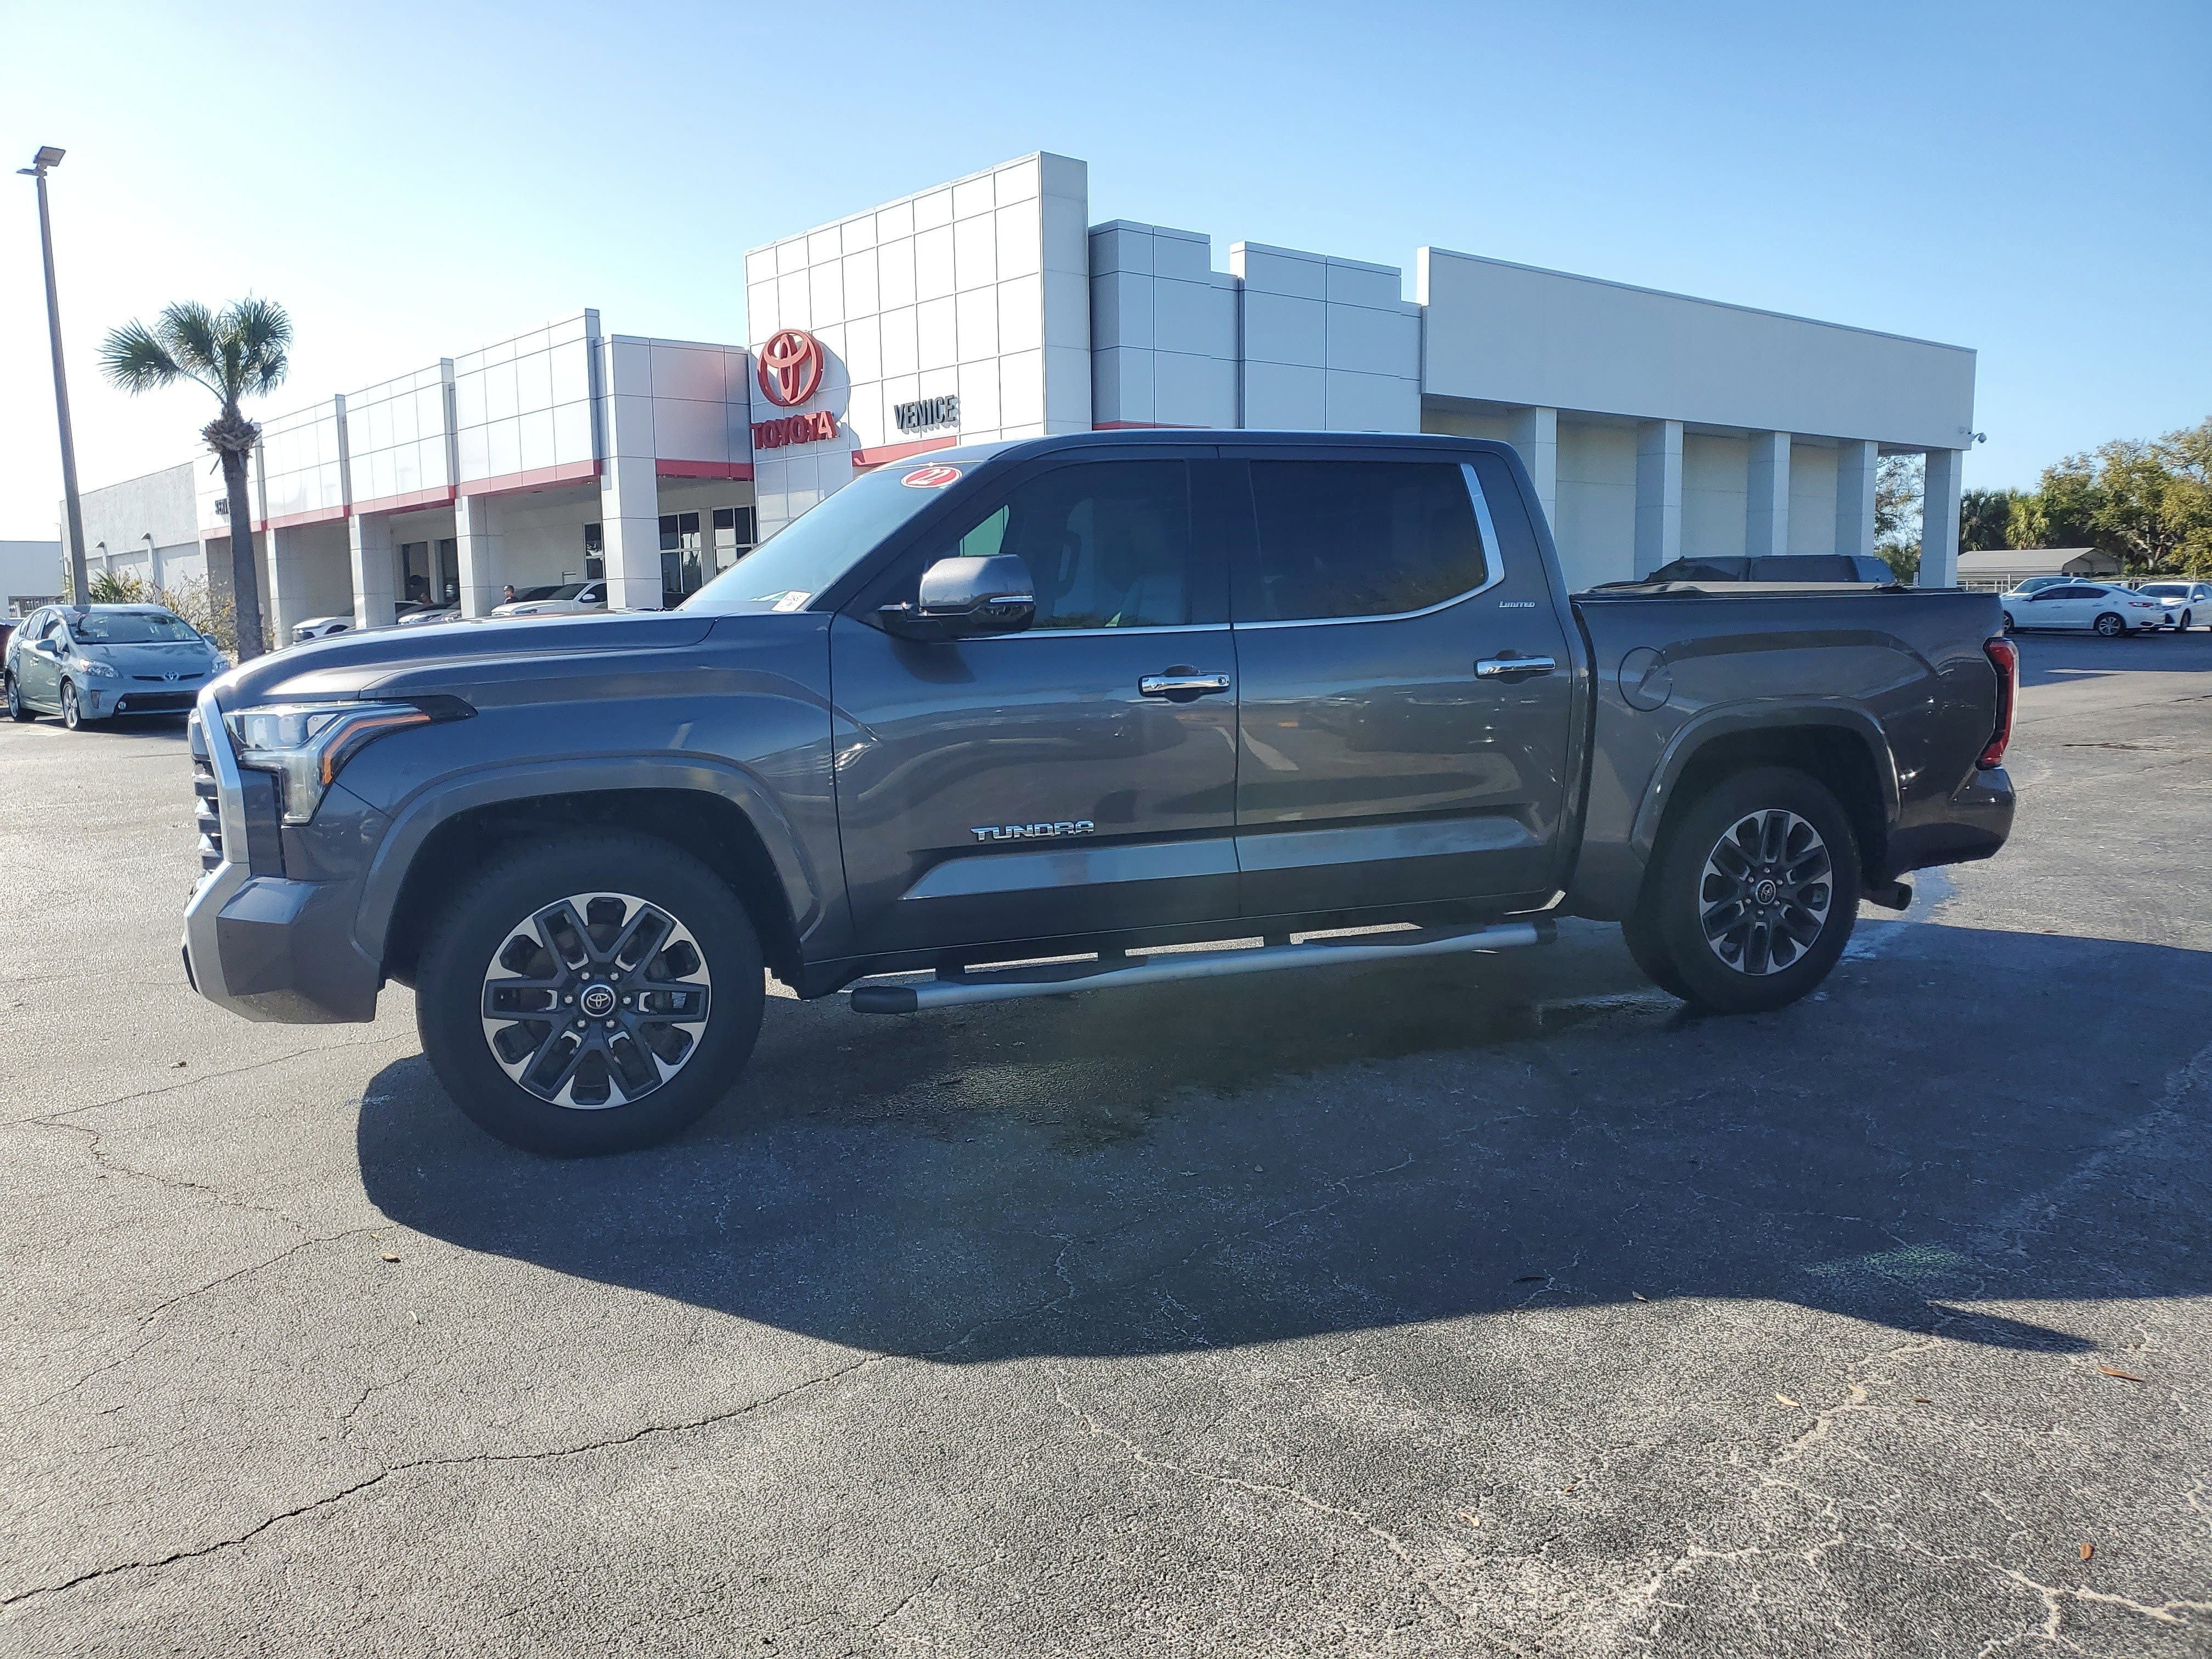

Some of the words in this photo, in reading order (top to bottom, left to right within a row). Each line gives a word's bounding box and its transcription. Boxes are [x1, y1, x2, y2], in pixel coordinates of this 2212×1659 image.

[751, 410, 837, 449] TOYOTA
[893, 394, 956, 430] VENICE
[970, 821, 1094, 841] TUNDRA
